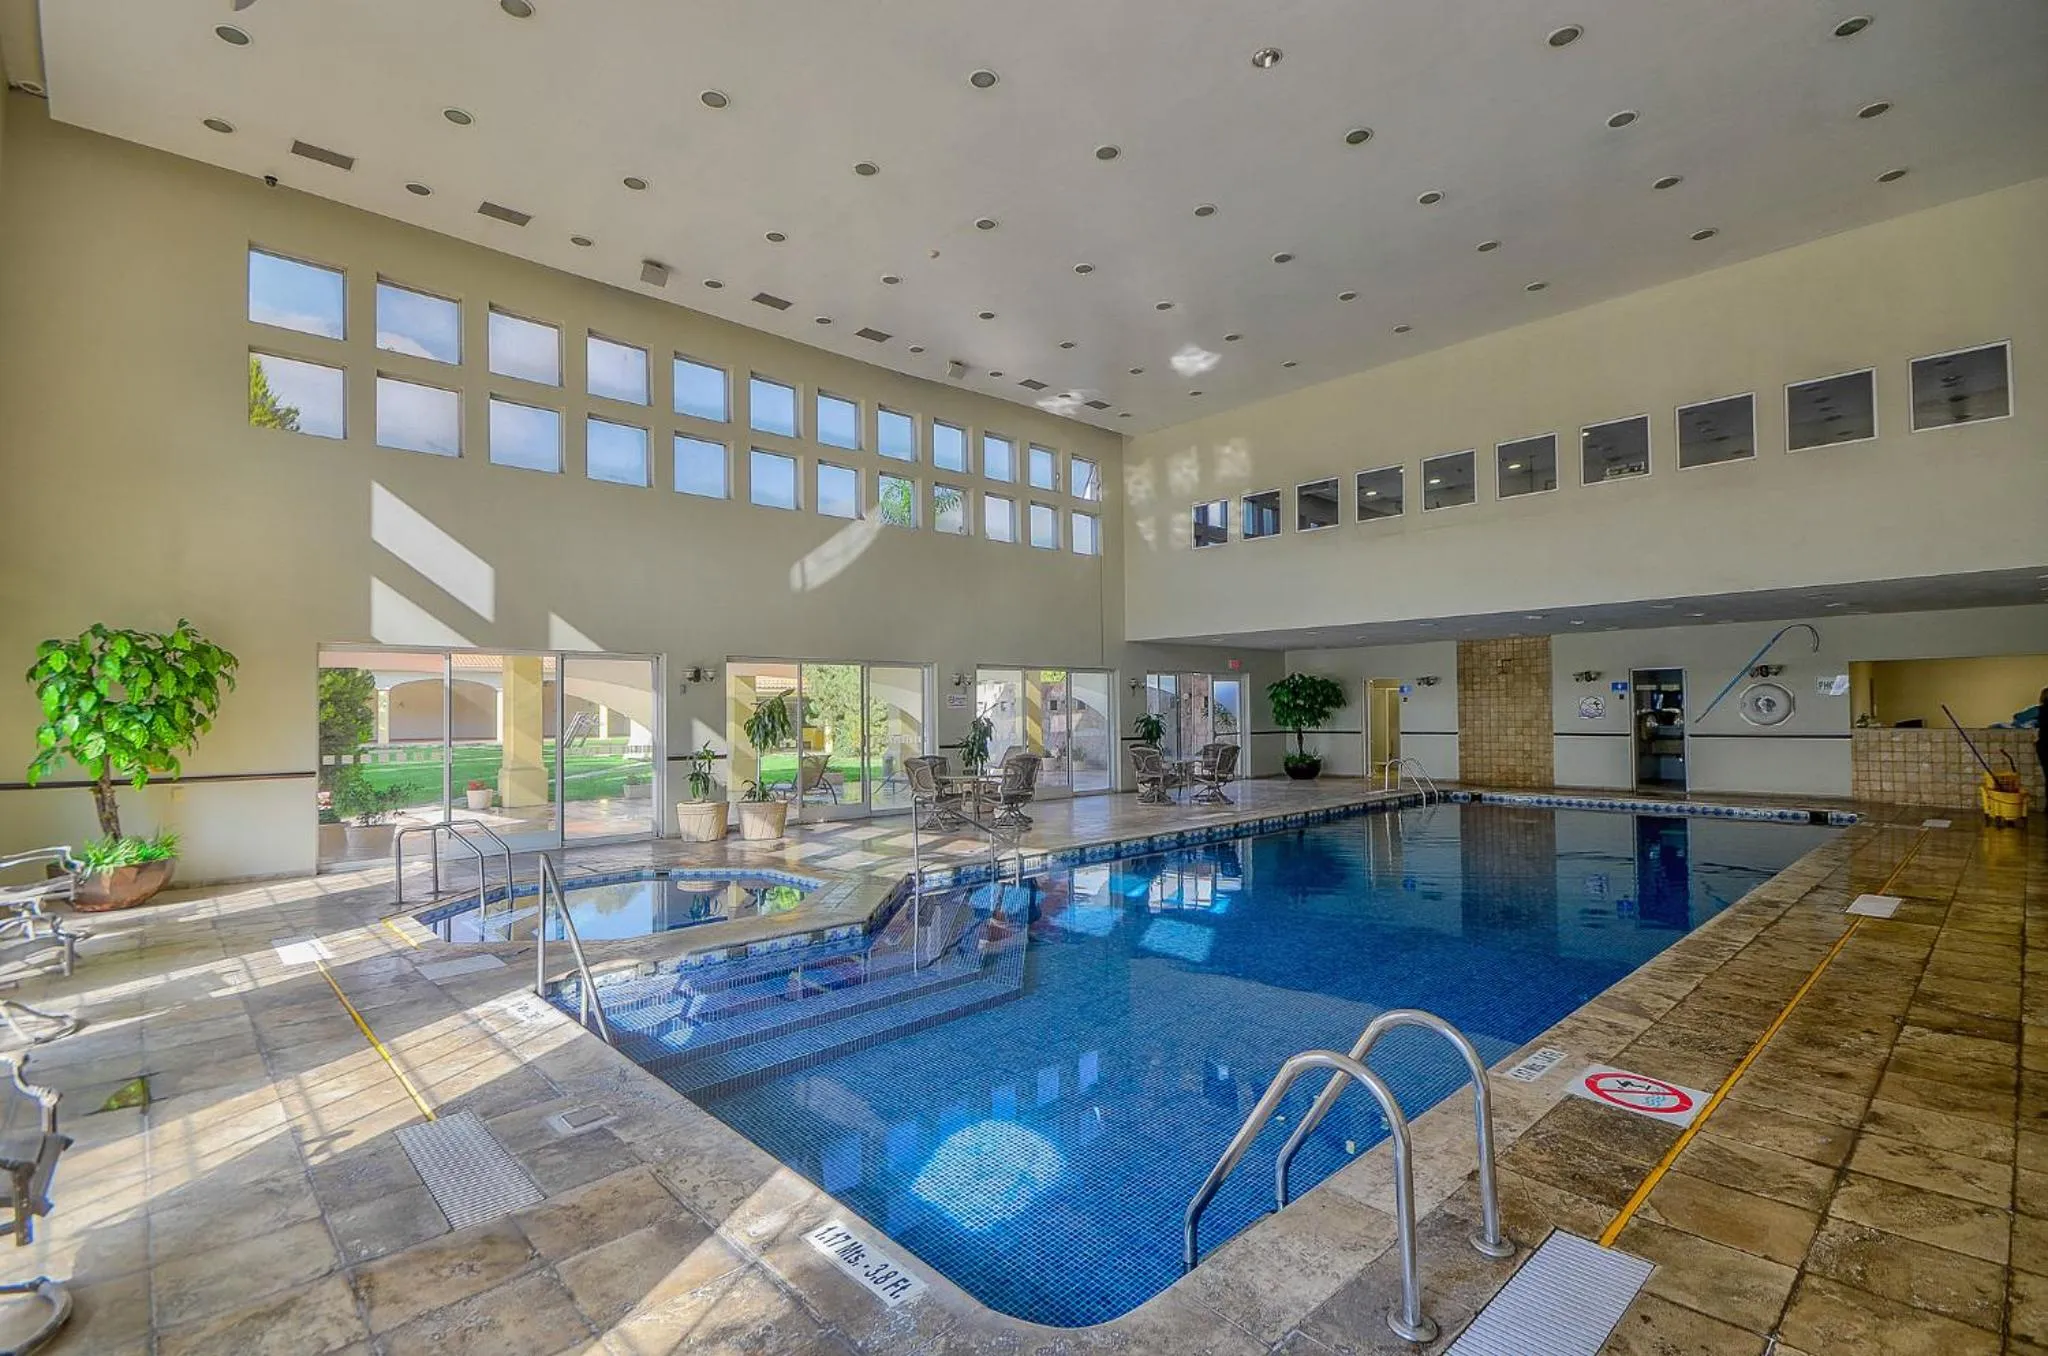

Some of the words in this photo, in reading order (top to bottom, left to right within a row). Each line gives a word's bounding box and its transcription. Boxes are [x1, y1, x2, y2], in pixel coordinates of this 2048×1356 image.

[815, 1225, 851, 1248] 1.17
[864, 1263, 898, 1286] 3.8
[883, 1277, 912, 1299] Ft.
